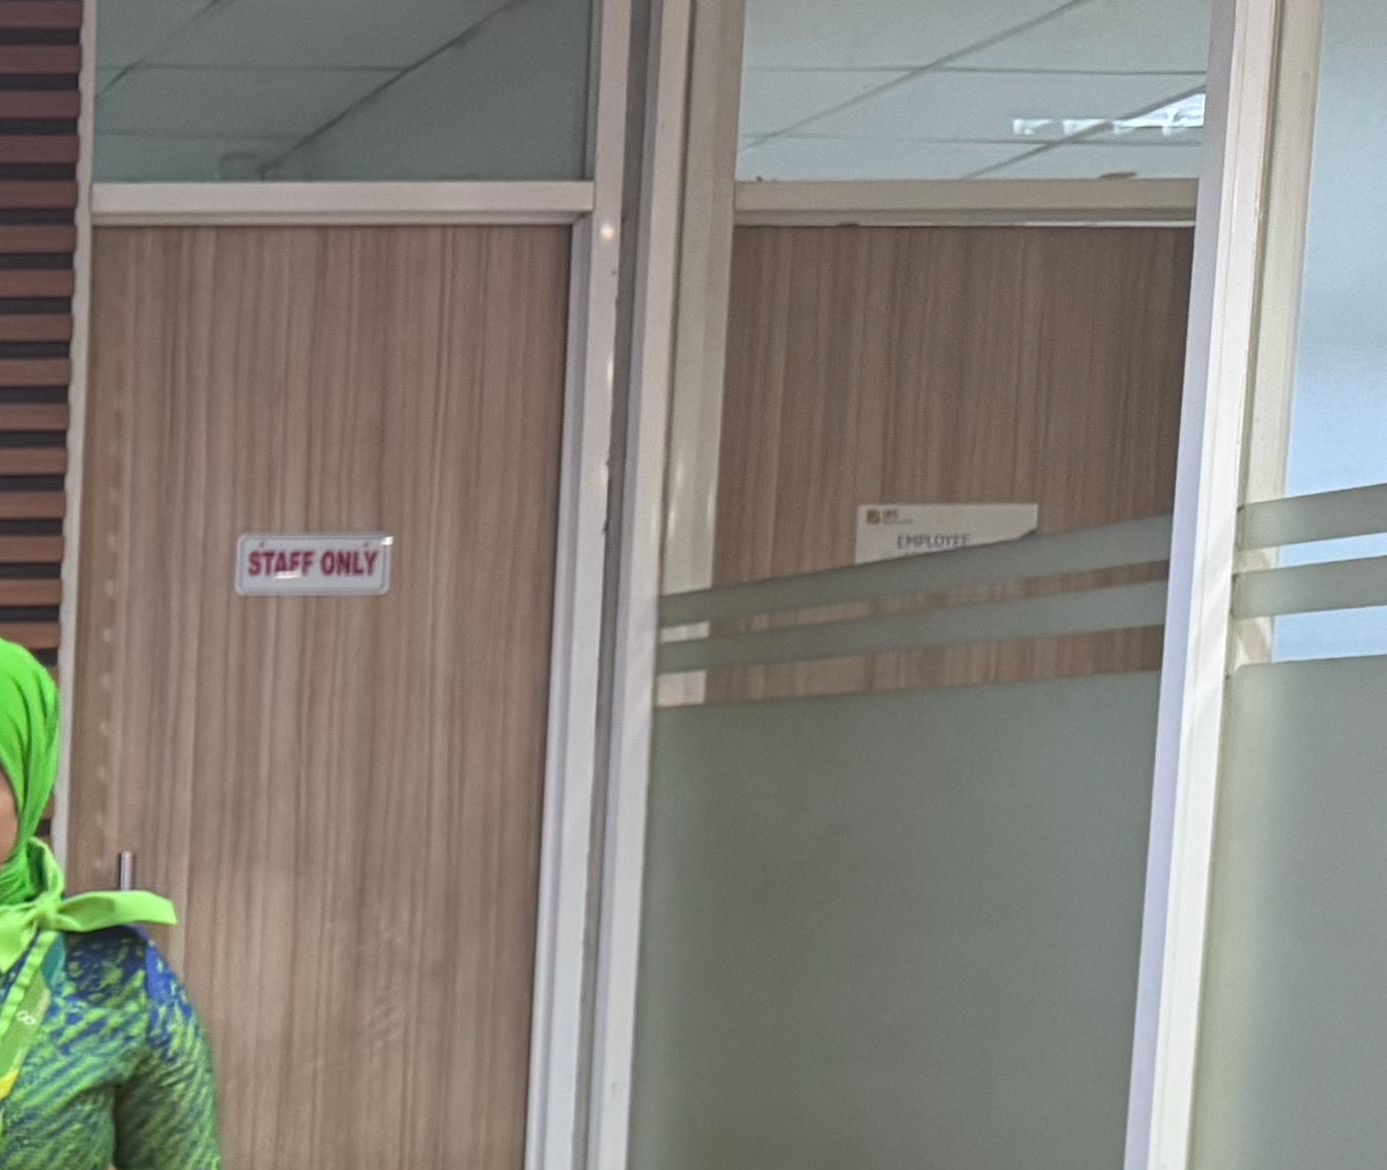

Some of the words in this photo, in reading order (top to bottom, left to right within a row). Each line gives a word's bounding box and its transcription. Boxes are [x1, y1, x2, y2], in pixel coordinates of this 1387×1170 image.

[896, 533, 970, 548] EMPLOYEE
[248, 551, 315, 576] STAFF
[320, 551, 378, 575] ONLY
